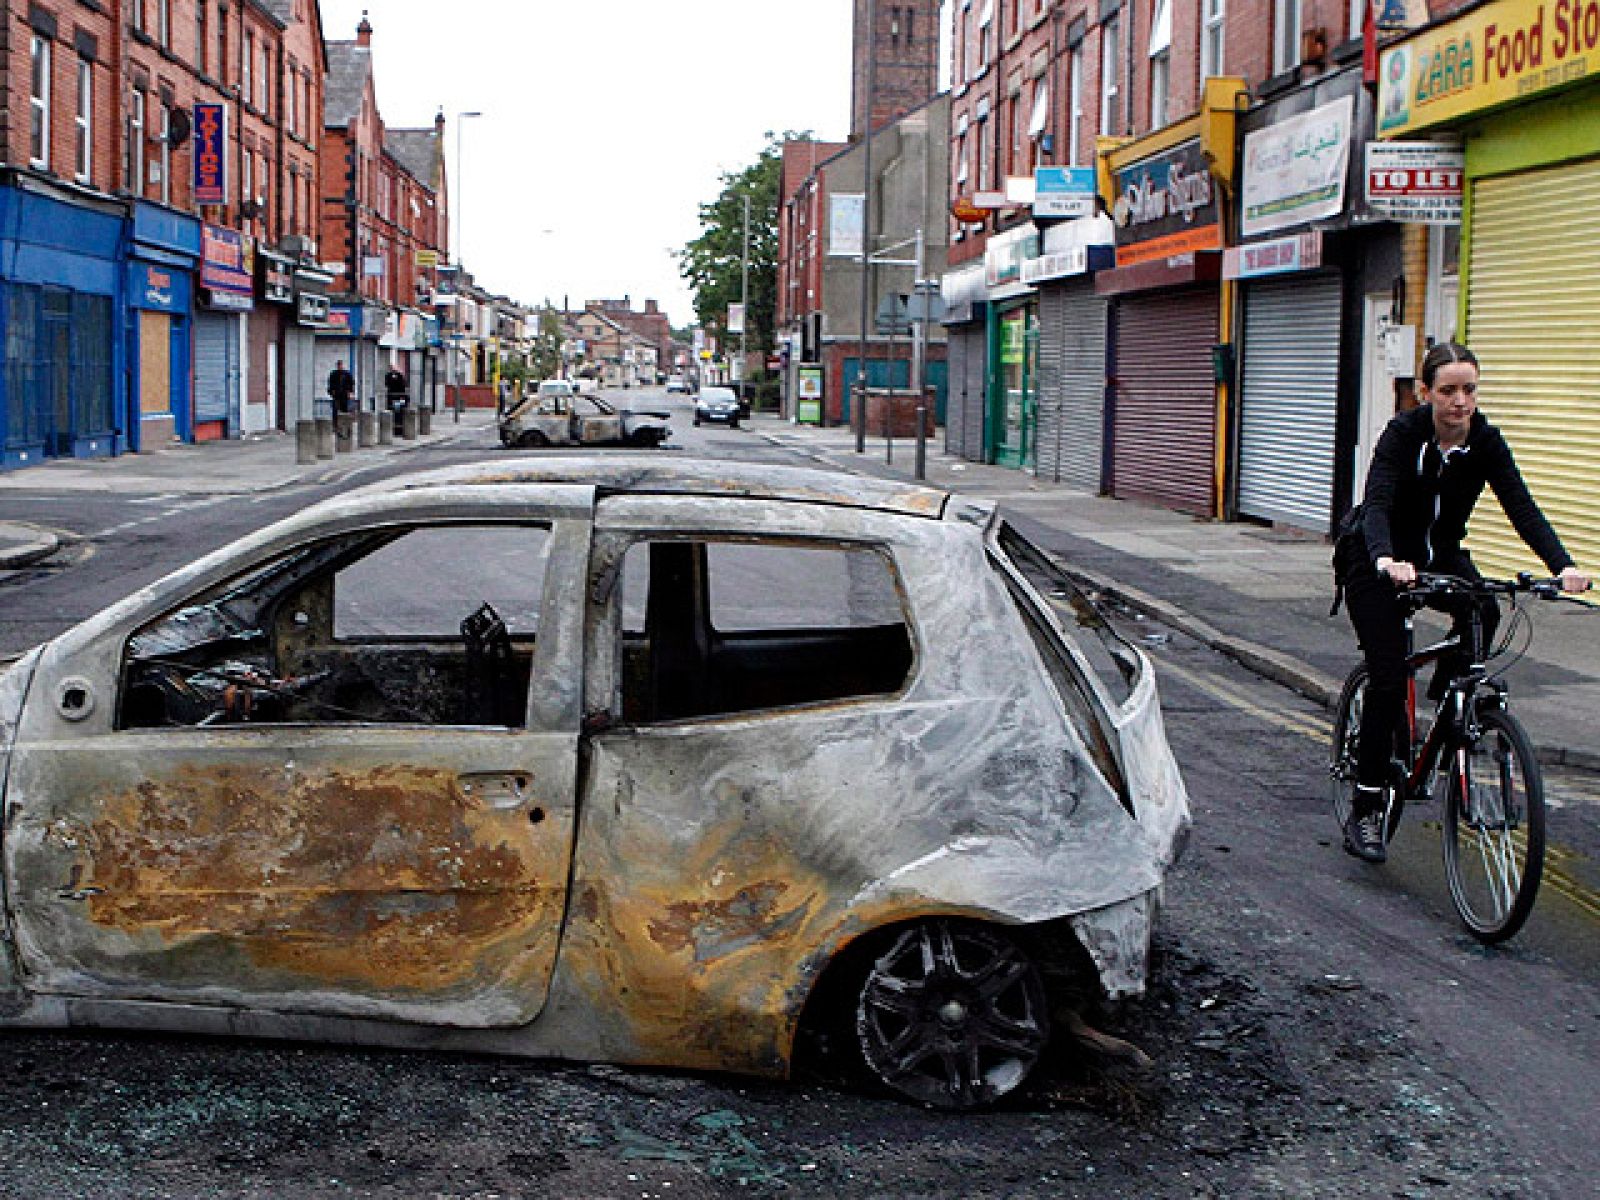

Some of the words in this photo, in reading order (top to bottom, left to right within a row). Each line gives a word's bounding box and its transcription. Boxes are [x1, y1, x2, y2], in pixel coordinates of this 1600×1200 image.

[1416, 33, 1474, 105] ZARA
[1483, 5, 1544, 83] Food
[1371, 171, 1409, 188] TO
[1416, 171, 1461, 188] LET
